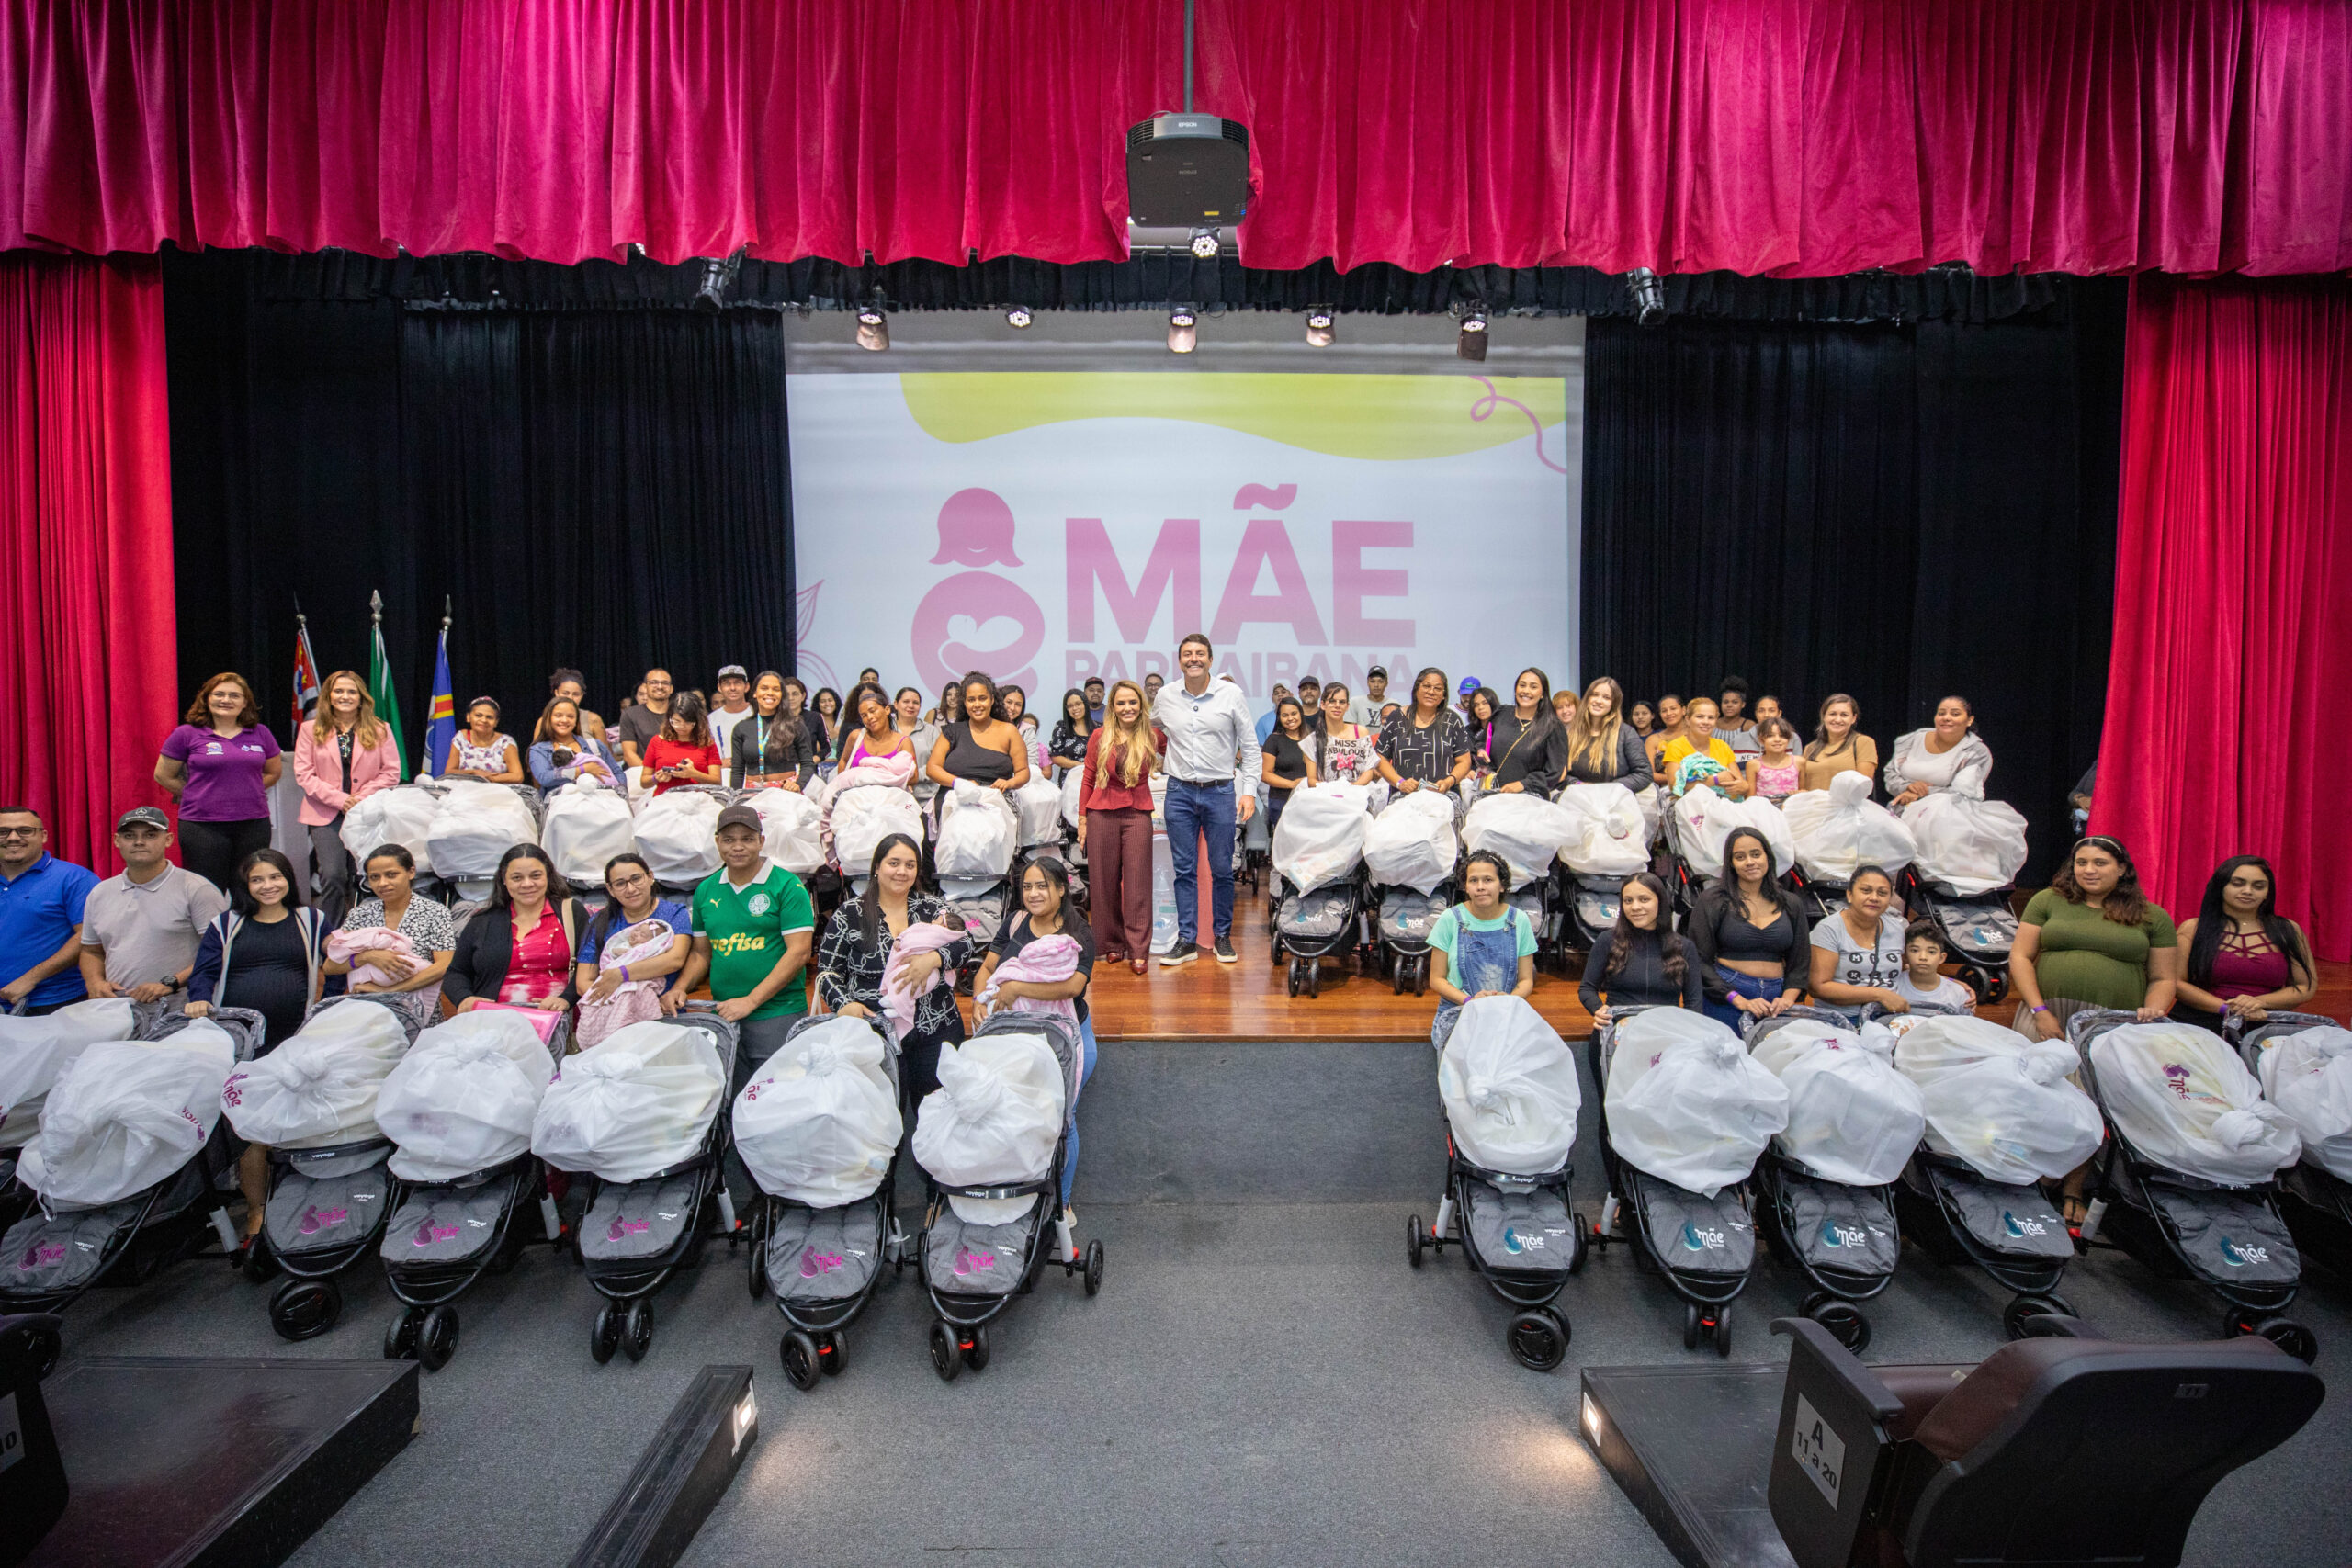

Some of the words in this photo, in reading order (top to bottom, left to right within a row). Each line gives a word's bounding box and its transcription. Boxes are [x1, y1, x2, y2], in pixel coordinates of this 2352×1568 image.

[1065, 483, 1416, 647] MÃE
[1065, 649, 1416, 698] PARAIBANA
[1334, 739, 1357, 748] MISS
[709, 932, 765, 956] refisa
[1693, 1227, 1724, 1249] mãe
[1833, 1226, 1866, 1248] mãe
[2012, 1217, 2046, 1237] mãe
[1513, 1233, 1545, 1251] mãe
[2230, 1243, 2268, 1265] mãe
[1811, 1420, 1824, 1451] A
[1797, 1431, 1809, 1455] 11
[1812, 1452, 1819, 1470] a
[1822, 1462, 1838, 1490] 20
